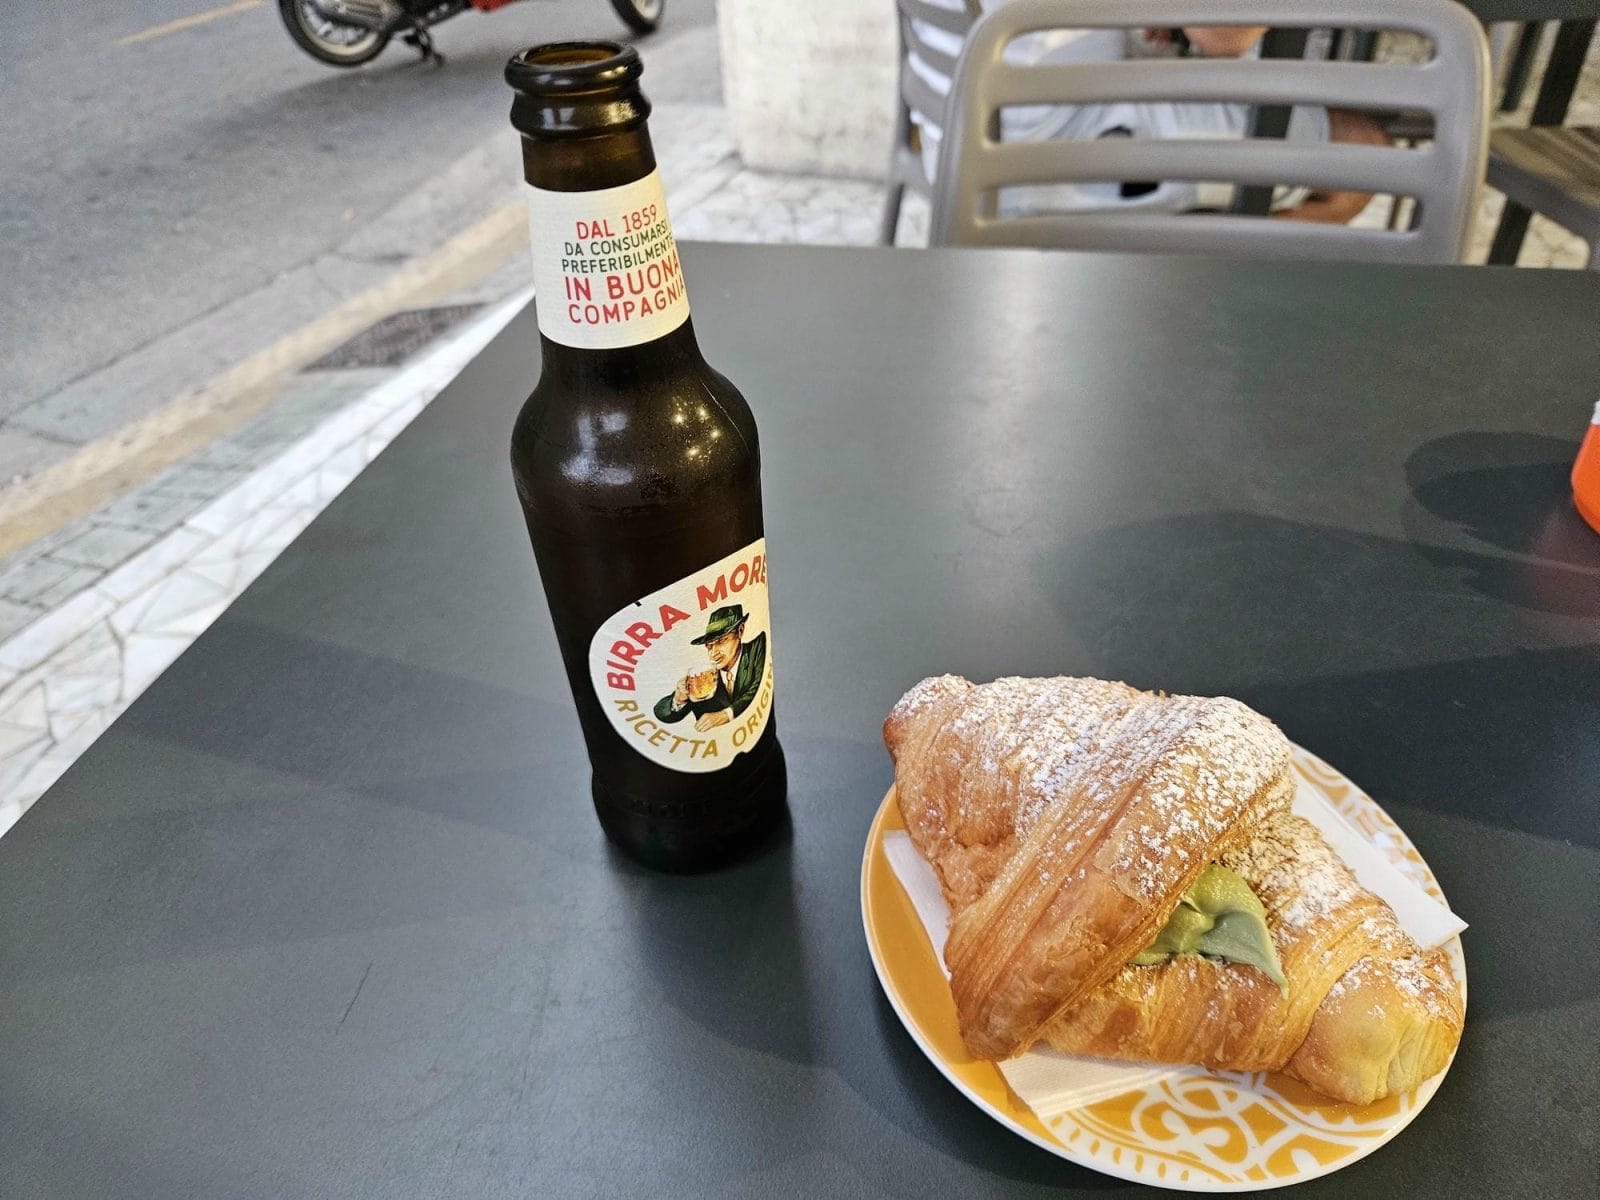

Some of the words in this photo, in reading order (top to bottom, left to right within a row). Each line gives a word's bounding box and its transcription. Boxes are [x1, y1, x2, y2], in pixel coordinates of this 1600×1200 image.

[576, 219, 615, 240] DAL
[622, 204, 657, 233] 1859
[564, 241, 584, 256] DA
[565, 276, 592, 301] IN
[606, 249, 679, 300] BUONA
[568, 274, 684, 325] COMPAGNIA
[606, 604, 691, 691] BIRRA
[614, 699, 718, 759] RICETTA
